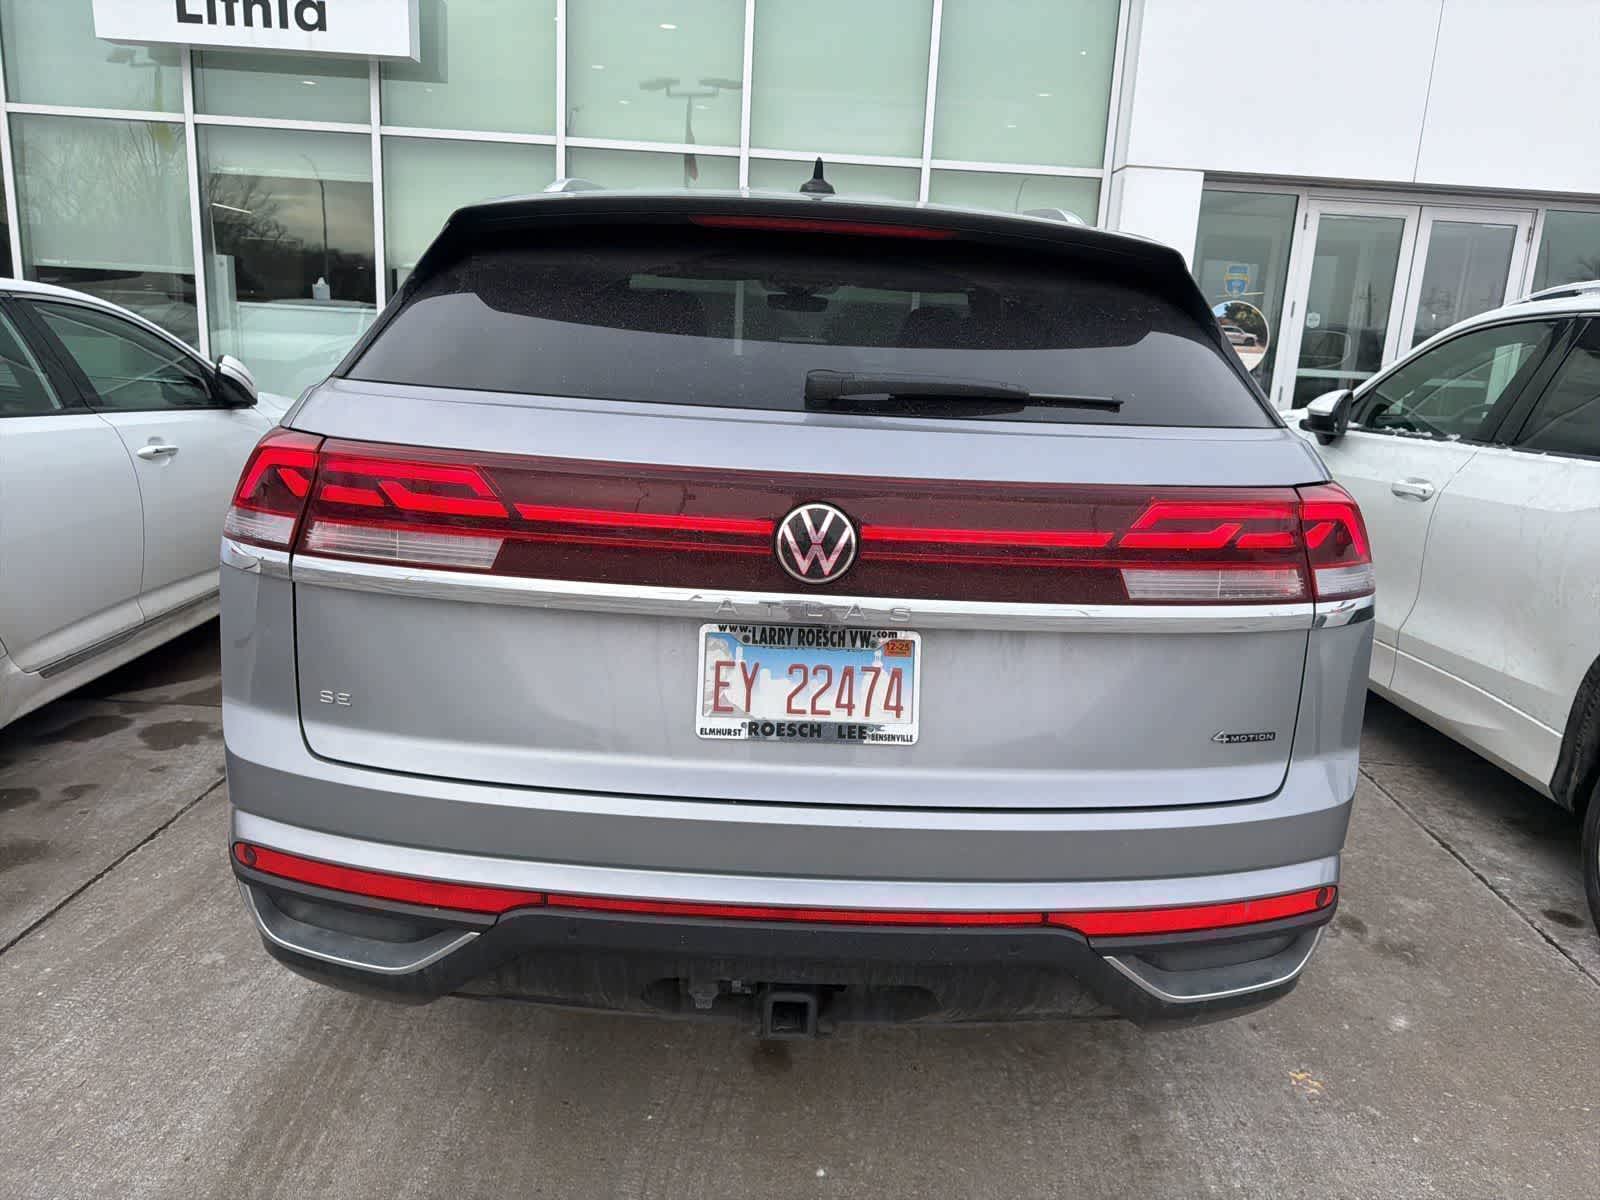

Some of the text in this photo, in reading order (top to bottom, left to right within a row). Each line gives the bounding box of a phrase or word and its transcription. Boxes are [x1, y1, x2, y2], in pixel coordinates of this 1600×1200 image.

[780, 506, 853, 579] VW
[714, 597, 911, 623] ATLAS
[797, 627, 846, 648] ROESCH
[713, 660, 904, 719] EY 22474
[319, 690, 351, 706] SE
[700, 727, 742, 737] ELMHURST
[748, 722, 822, 738] ROESCH
[871, 733, 913, 743] BENSENVILLE
[1212, 730, 1274, 743] 4MOTION
